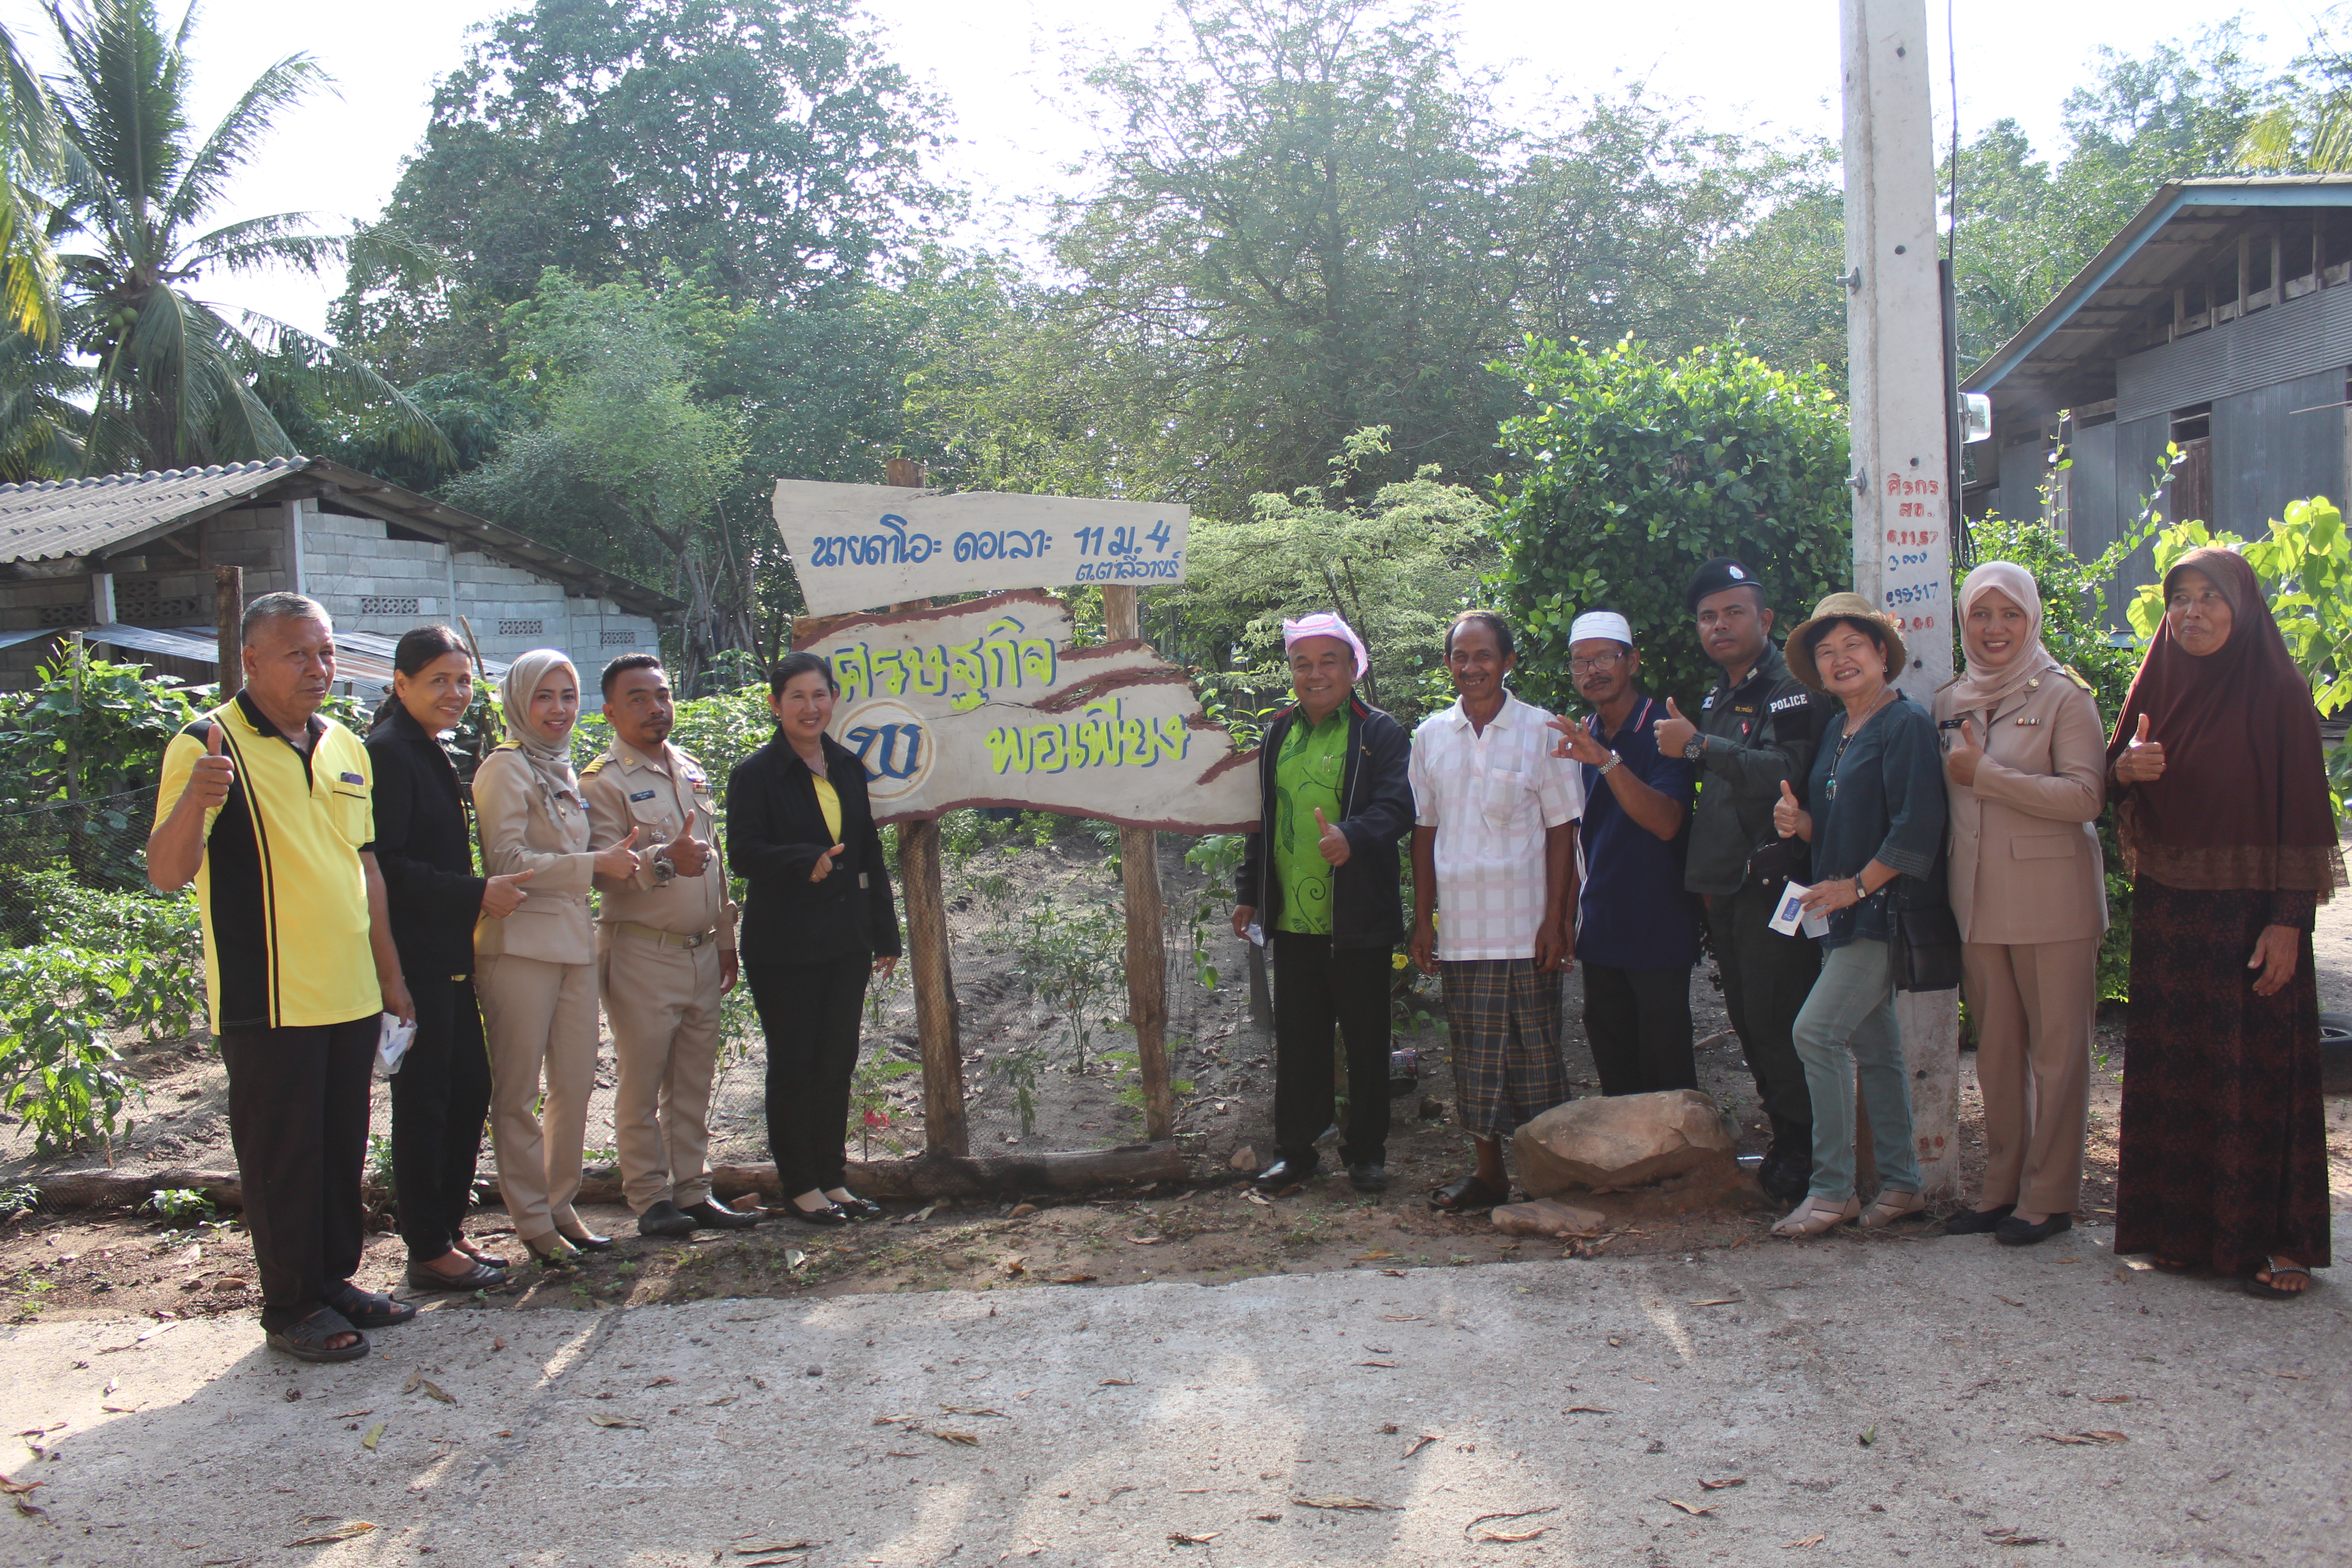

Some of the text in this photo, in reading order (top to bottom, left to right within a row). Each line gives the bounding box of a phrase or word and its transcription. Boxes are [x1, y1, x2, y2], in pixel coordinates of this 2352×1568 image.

[954, 529, 1052, 562] ดอเลาะ
[821, 616, 1056, 710] ศรษฐกิจ
[1770, 694, 1808, 713] POLICE
[984, 697, 1191, 774] พอเพียง
